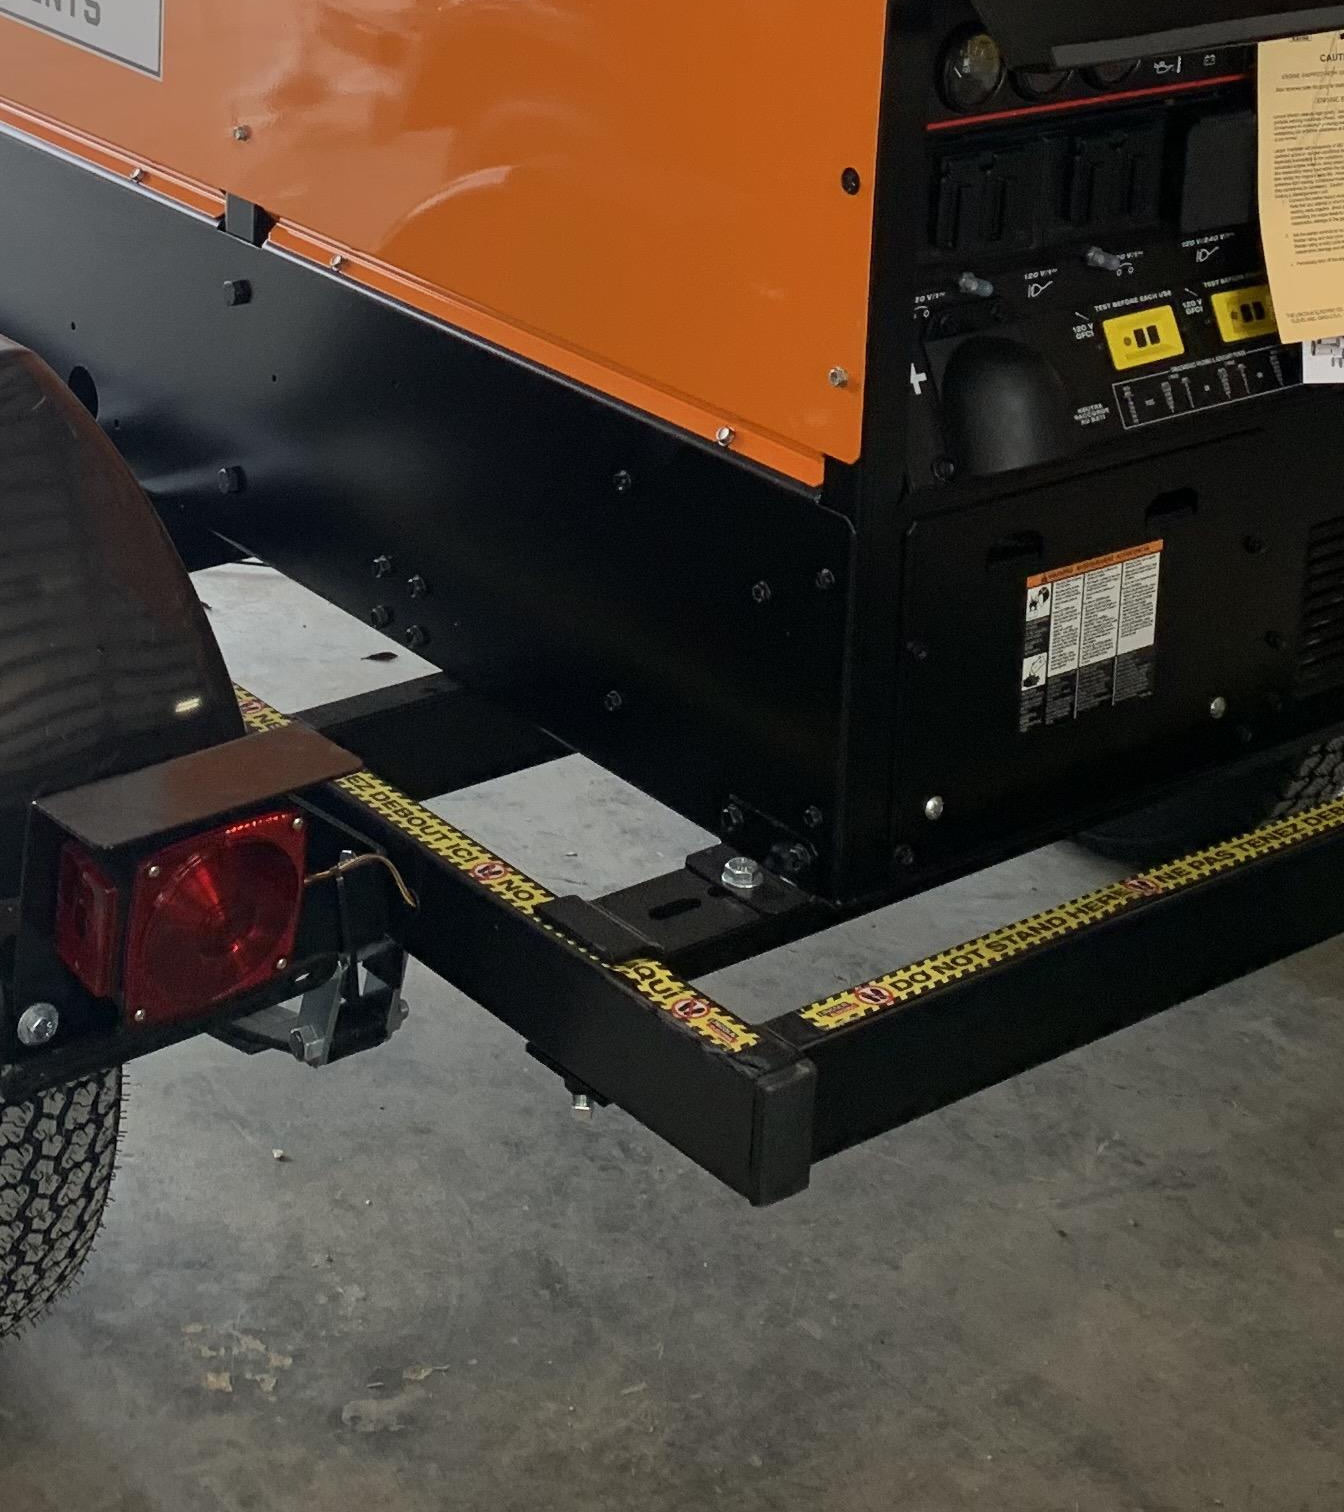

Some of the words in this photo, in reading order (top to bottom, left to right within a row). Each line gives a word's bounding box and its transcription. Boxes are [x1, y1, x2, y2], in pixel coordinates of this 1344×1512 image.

[369, 790, 446, 850] DEBOUT
[446, 844, 481, 864] ICI
[1188, 848, 1238, 871] PAS
[1233, 821, 1303, 852] TENEZ
[497, 878, 535, 902] NO
[889, 968, 932, 993] DO
[933, 947, 986, 978] NOT
[986, 914, 1067, 952] STAND
[1066, 886, 1126, 921] HERE
[632, 964, 681, 1001] QUI
